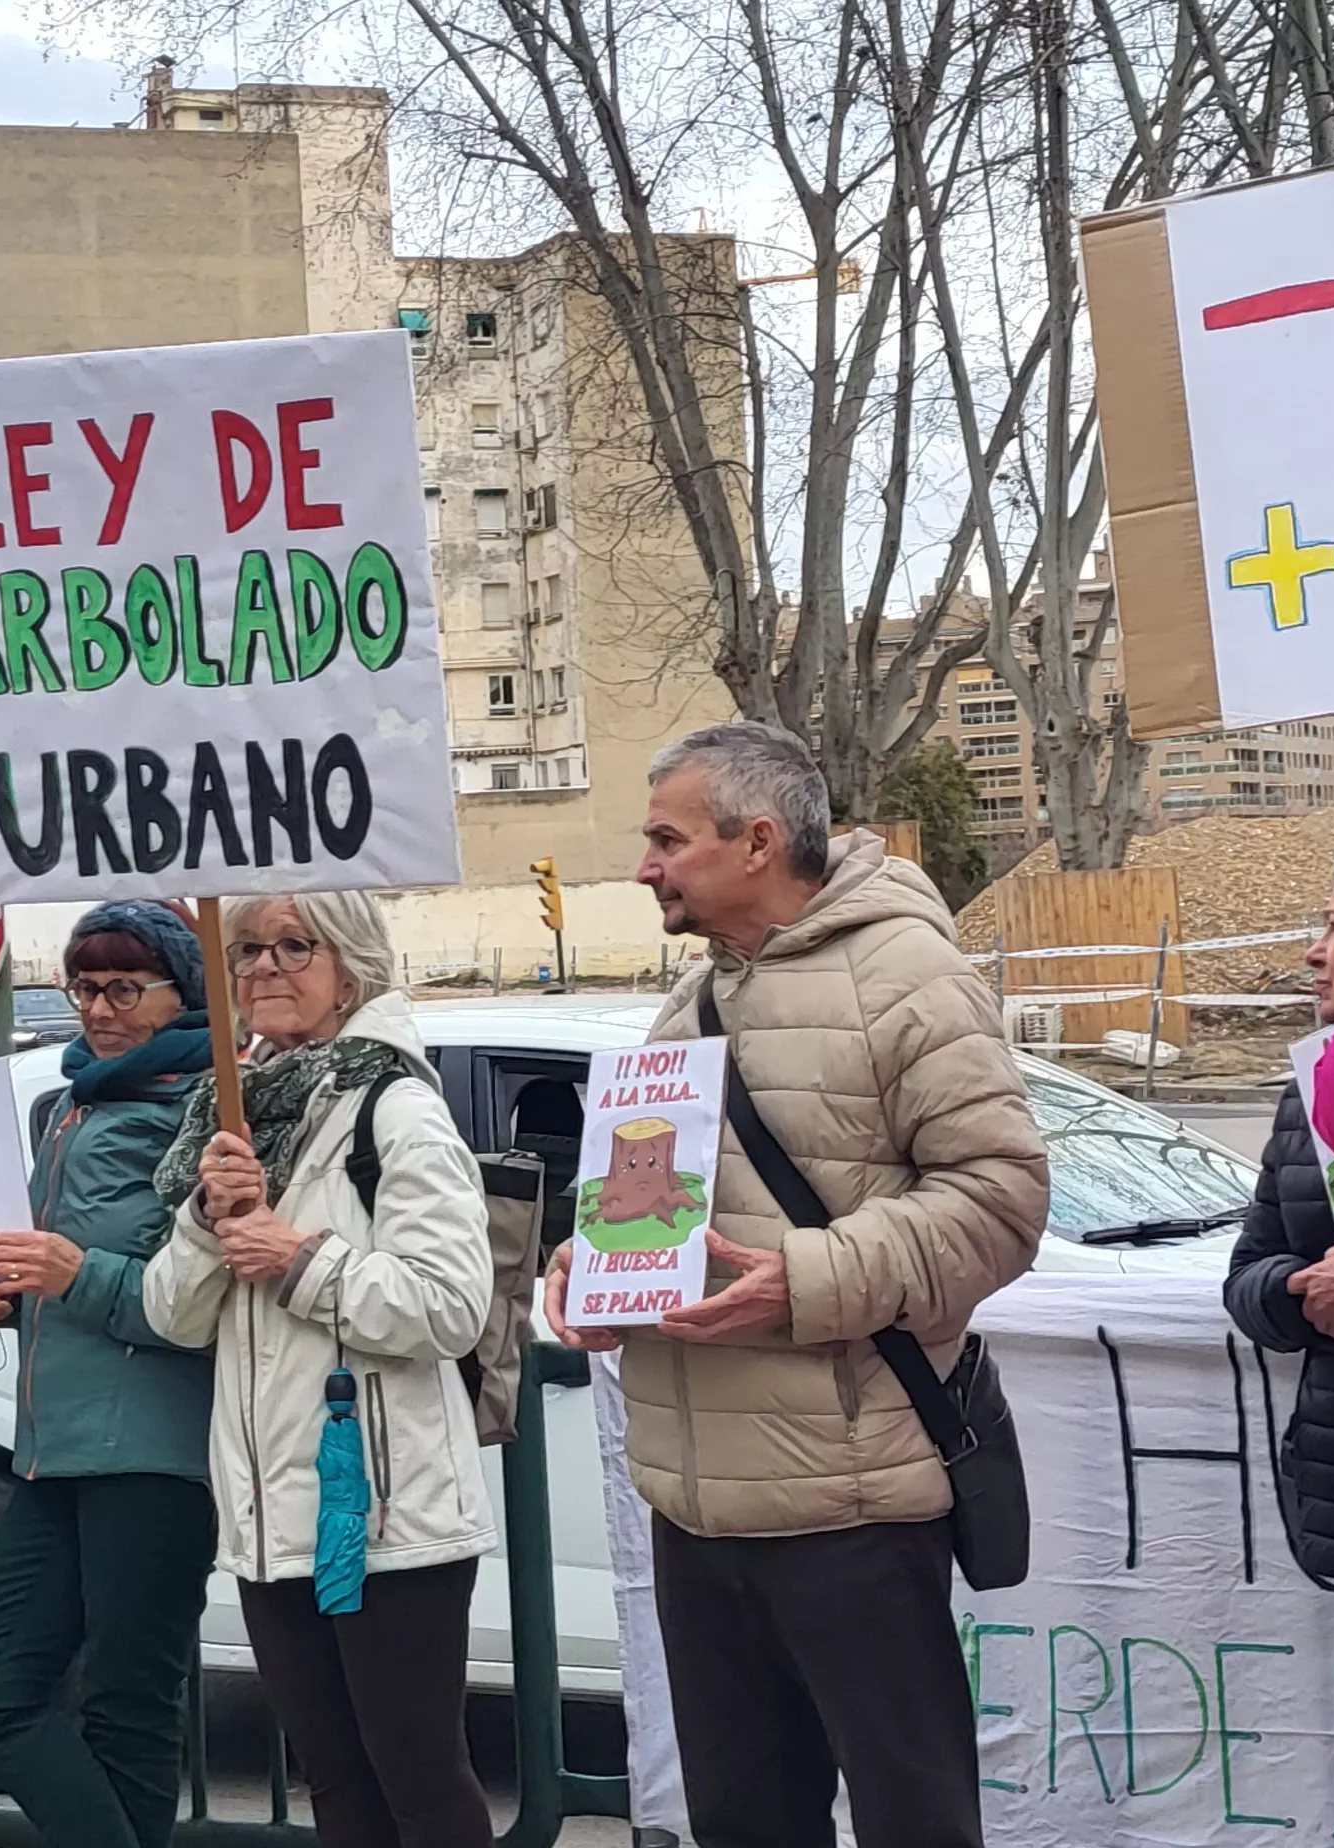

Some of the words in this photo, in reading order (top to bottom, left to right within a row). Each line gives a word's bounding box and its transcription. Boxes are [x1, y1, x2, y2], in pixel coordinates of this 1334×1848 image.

[211, 397, 344, 533] DE
[598, 1089, 614, 1109] A
[617, 1086, 639, 1107] LA
[604, 1248, 679, 1272] HUESCA
[582, 1293, 604, 1315] SE
[605, 1288, 684, 1314] PLANTA
